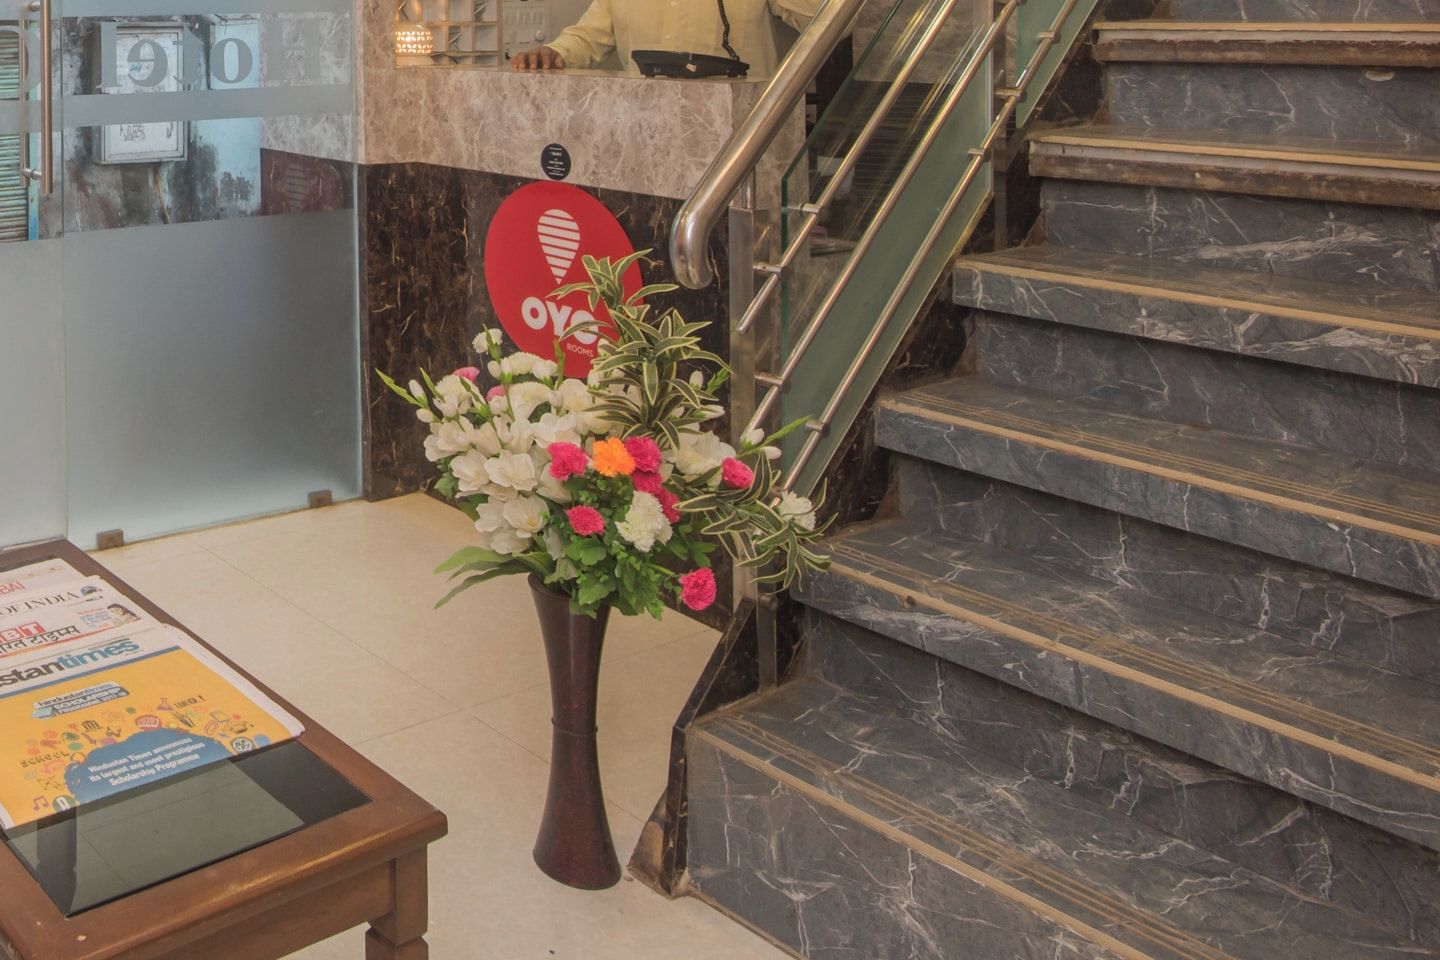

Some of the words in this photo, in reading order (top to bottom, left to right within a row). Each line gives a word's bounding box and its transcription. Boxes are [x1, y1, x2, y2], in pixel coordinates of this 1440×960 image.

[521, 296, 599, 345] OYO
[566, 342, 594, 358] ROOMS
[24, 592, 80, 612] INDIA
[28, 624, 82, 648] टाइम्स
[88, 757, 129, 773] Hindustan
[128, 751, 153, 762] Times
[101, 766, 129, 779] largest
[129, 761, 144, 771] and
[144, 755, 164, 767] most
[108, 767, 157, 786] Scholarship
[155, 753, 200, 773] Programme
